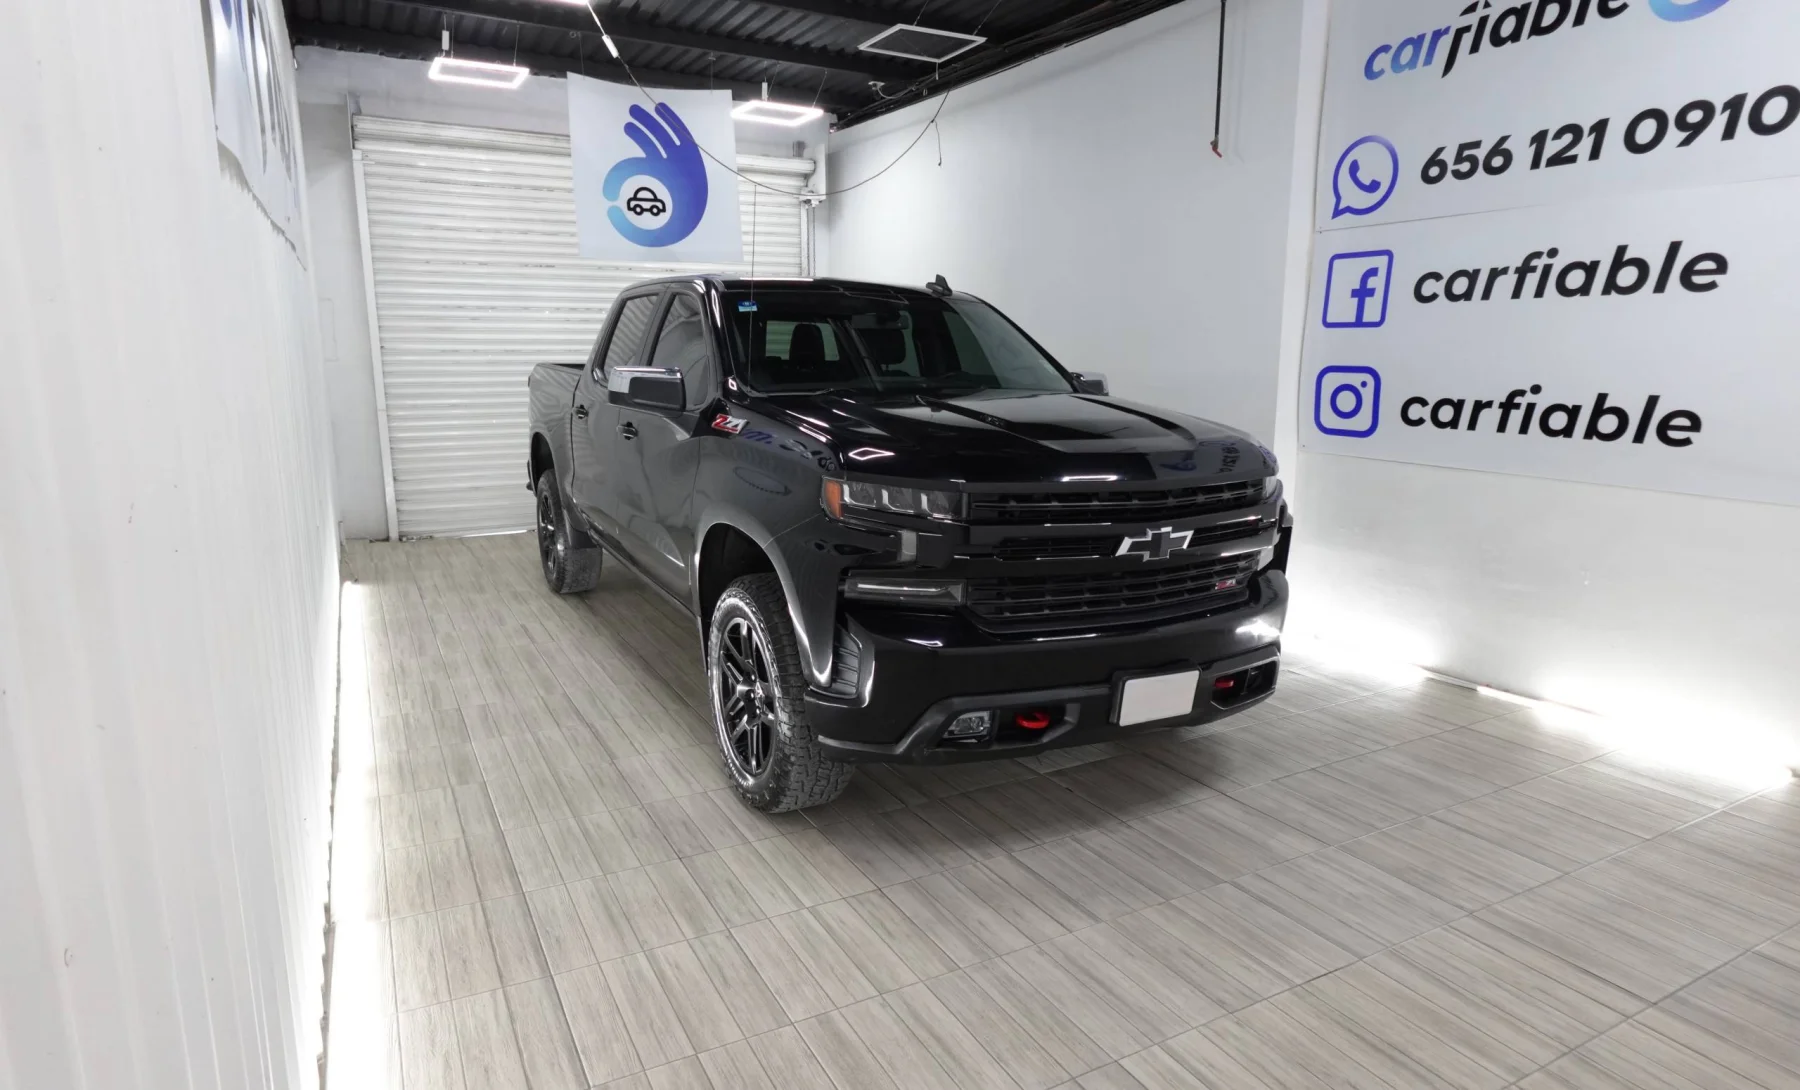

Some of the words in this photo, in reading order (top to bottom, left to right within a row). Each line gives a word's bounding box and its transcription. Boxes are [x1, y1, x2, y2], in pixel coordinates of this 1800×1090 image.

[1420, 134, 1514, 185] 656
[1528, 117, 1610, 171] 121
[1623, 84, 1800, 155] 0910
[1413, 240, 1729, 304] carfiable
[1400, 384, 1702, 448] carfiable
